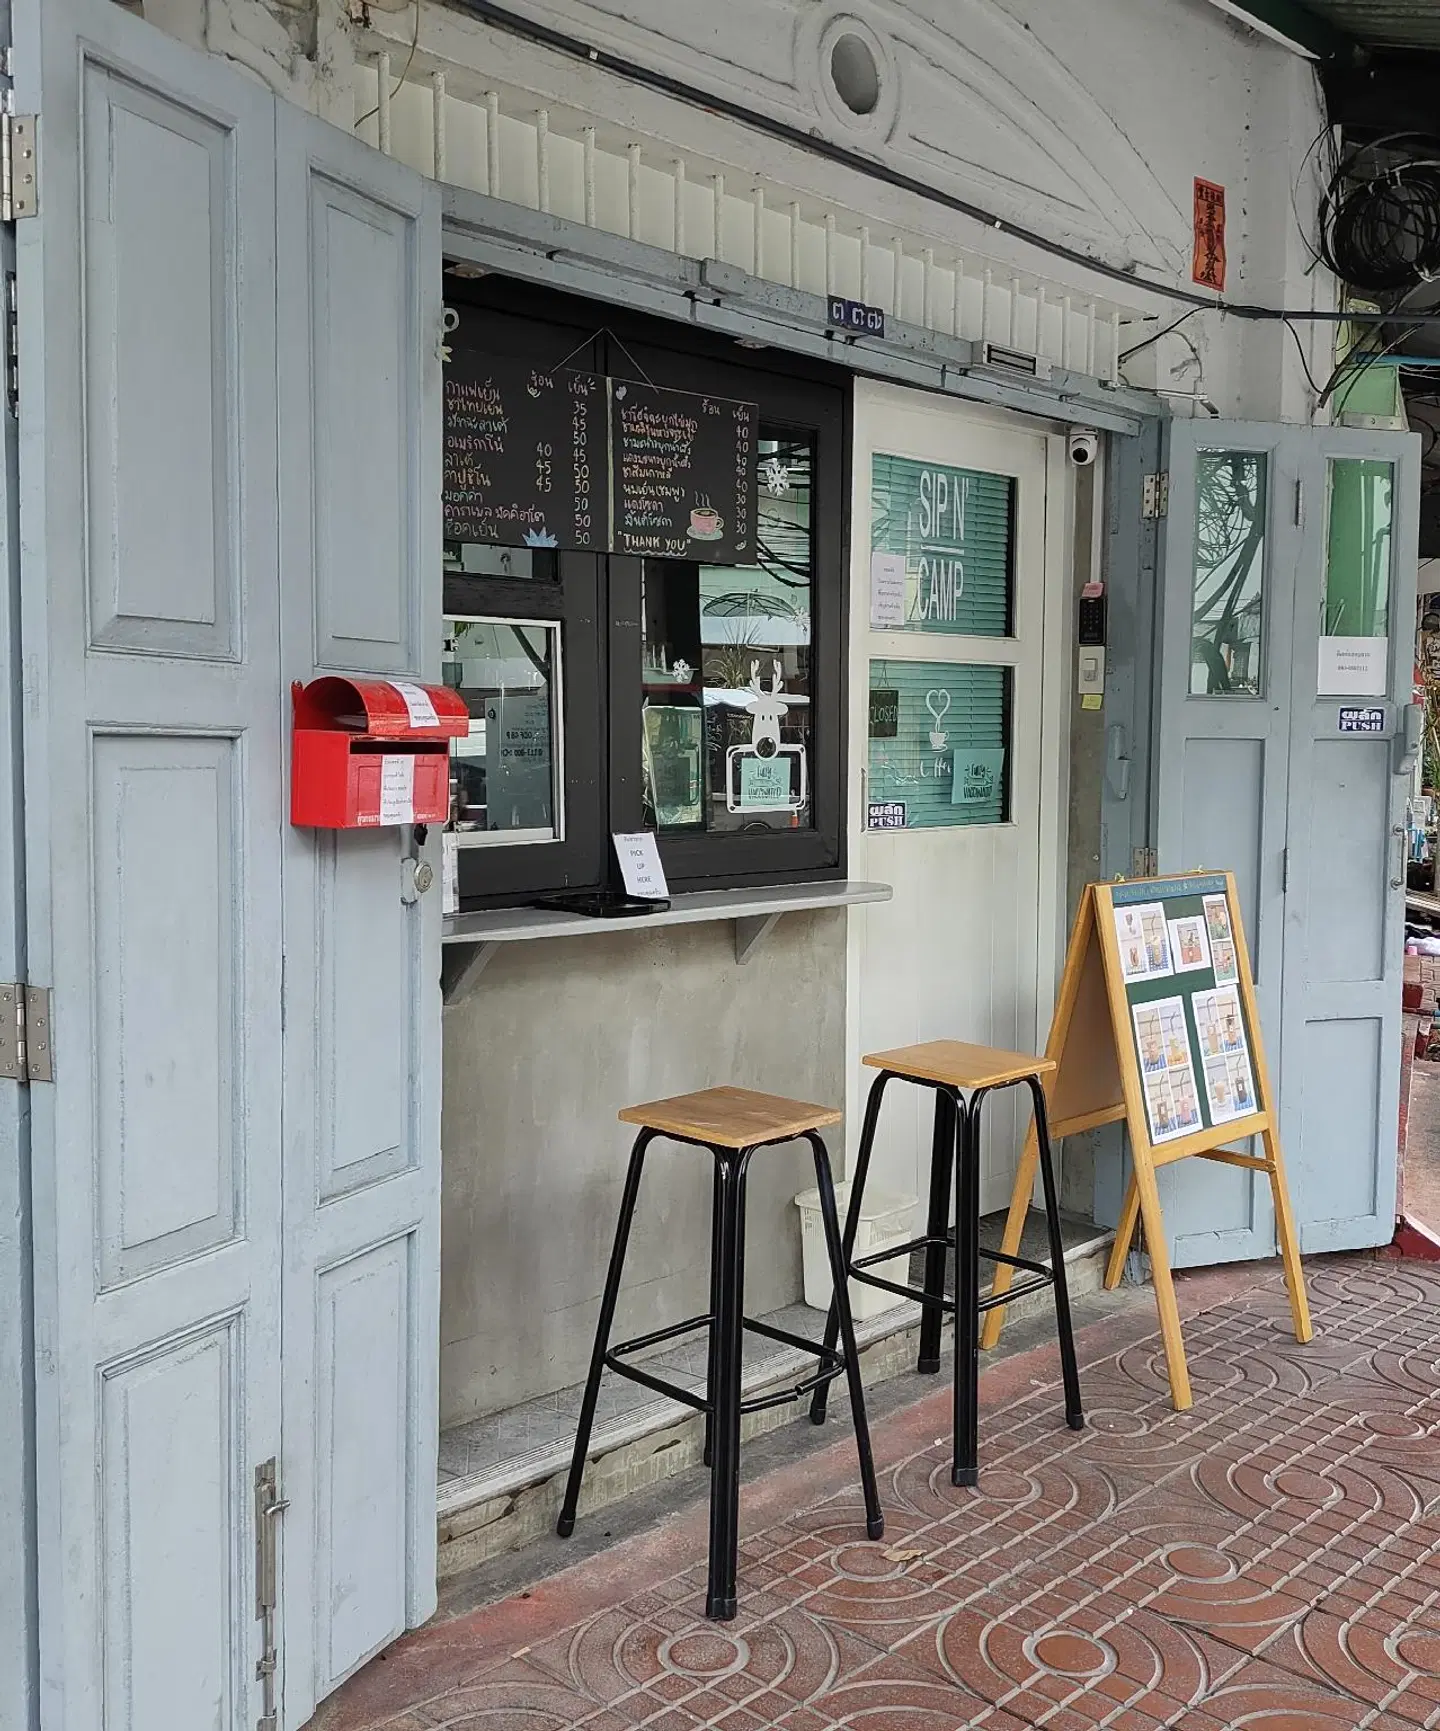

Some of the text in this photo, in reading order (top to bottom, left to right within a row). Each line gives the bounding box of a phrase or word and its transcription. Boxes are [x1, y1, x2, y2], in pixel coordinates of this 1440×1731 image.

[531, 370, 588, 396] ร้อน เย็น
[573, 400, 588, 416] 35
[572, 415, 587, 431] 45
[573, 431, 588, 446] 50
[736, 425, 749, 439] 40
[536, 442, 553, 457] 40
[573, 447, 587, 463] 45
[736, 440, 749, 453] 40
[736, 453, 747, 466] 40
[536, 458, 552, 475] 45
[573, 464, 590, 479] 50
[536, 475, 552, 492] 45
[574, 480, 590, 494] 50
[736, 479, 748, 492] 40
[573, 497, 589, 512] 50
[736, 493, 747, 505] 30
[919, 470, 948, 538] SIP
[736, 506, 747, 519] 30
[575, 514, 591, 528] 50
[736, 521, 747, 534] 30
[575, 530, 591, 545] 50
[917, 556, 964, 621] CAMP
[1341, 708, 1382, 721] ผลัก
[1341, 721, 1382, 731] PUSH
[869, 802, 904, 816] ผลัก
[869, 815, 904, 827] PUSH
